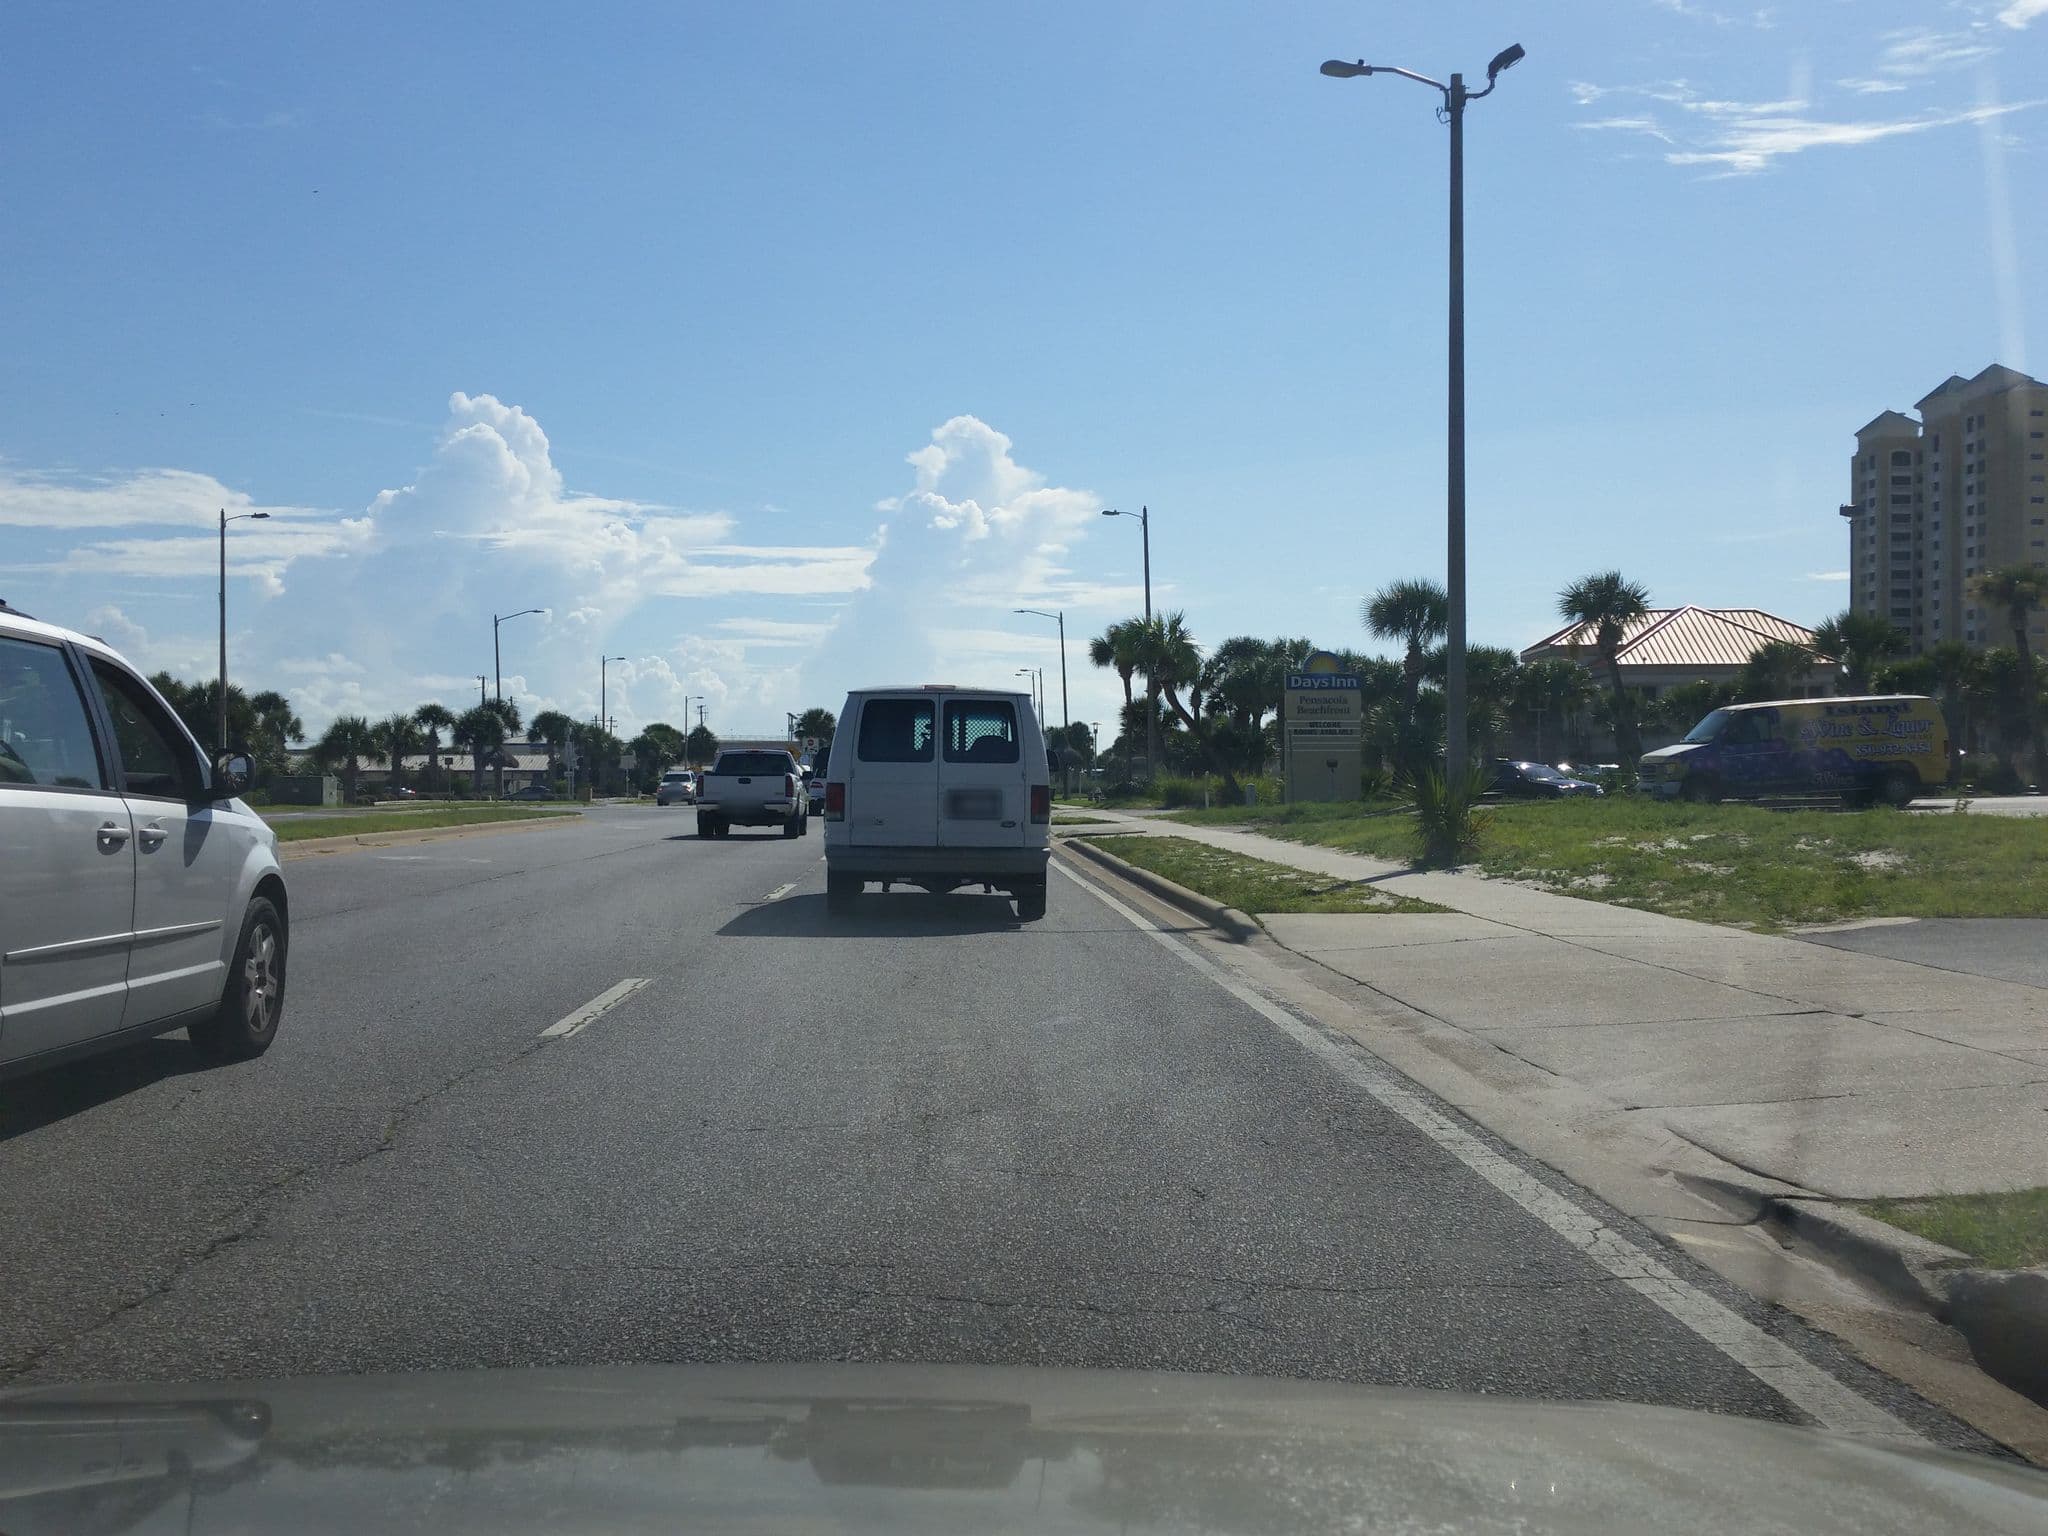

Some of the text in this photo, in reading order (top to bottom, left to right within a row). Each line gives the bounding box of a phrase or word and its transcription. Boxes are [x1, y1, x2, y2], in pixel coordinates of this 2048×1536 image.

[1291, 676, 1357, 688] Days Inn
[1299, 696, 1347, 704] Pensacola
[1297, 705, 1350, 714] Beachfront
[1800, 711, 1933, 738] Wine & Liquor
